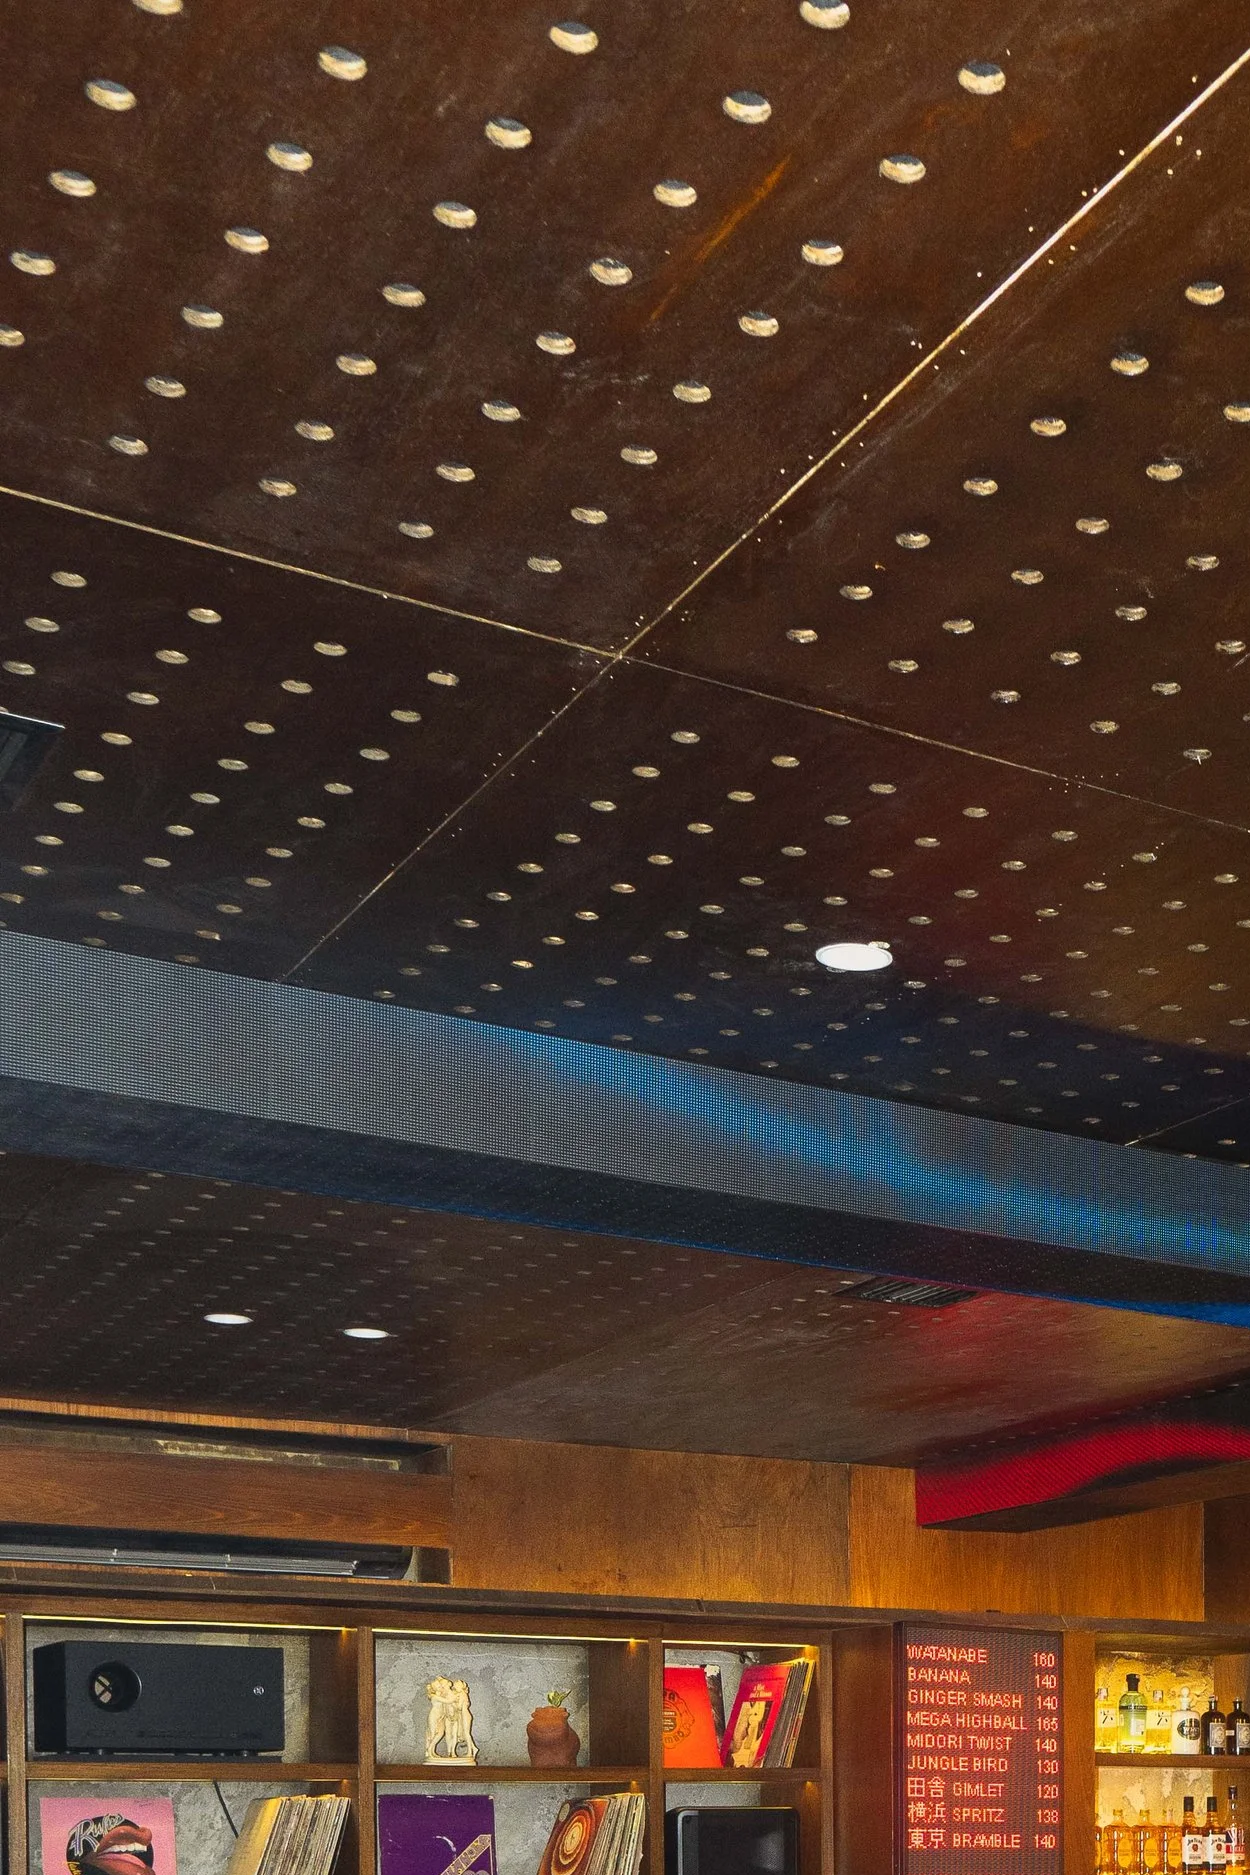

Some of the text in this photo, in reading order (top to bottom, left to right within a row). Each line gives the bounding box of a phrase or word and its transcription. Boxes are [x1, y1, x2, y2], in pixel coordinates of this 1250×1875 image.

[906, 1645, 988, 1663] WATANABE
[907, 1667, 971, 1684] BANANA
[1035, 1675, 1057, 1688] 140
[908, 1689, 1023, 1708] GINGER SMASH
[1036, 1696, 1058, 1710] 140
[906, 1711, 1028, 1730] MEGA HIGHBALL
[1036, 1717, 1058, 1731] 165
[906, 1733, 1012, 1750] MIDORI TWIST
[1035, 1738, 1057, 1752] 140
[907, 1755, 1008, 1772] JUNGLE BIRD
[1037, 1759, 1059, 1774] 130
[952, 1782, 1005, 1797] GIMLET
[1037, 1784, 1059, 1799] 120
[952, 1807, 1005, 1823] SPRITZ
[1037, 1809, 1059, 1823] 138
[907, 1827, 1021, 1849] 東京 BRAMBLE
[1034, 1834, 1056, 1849] 140
